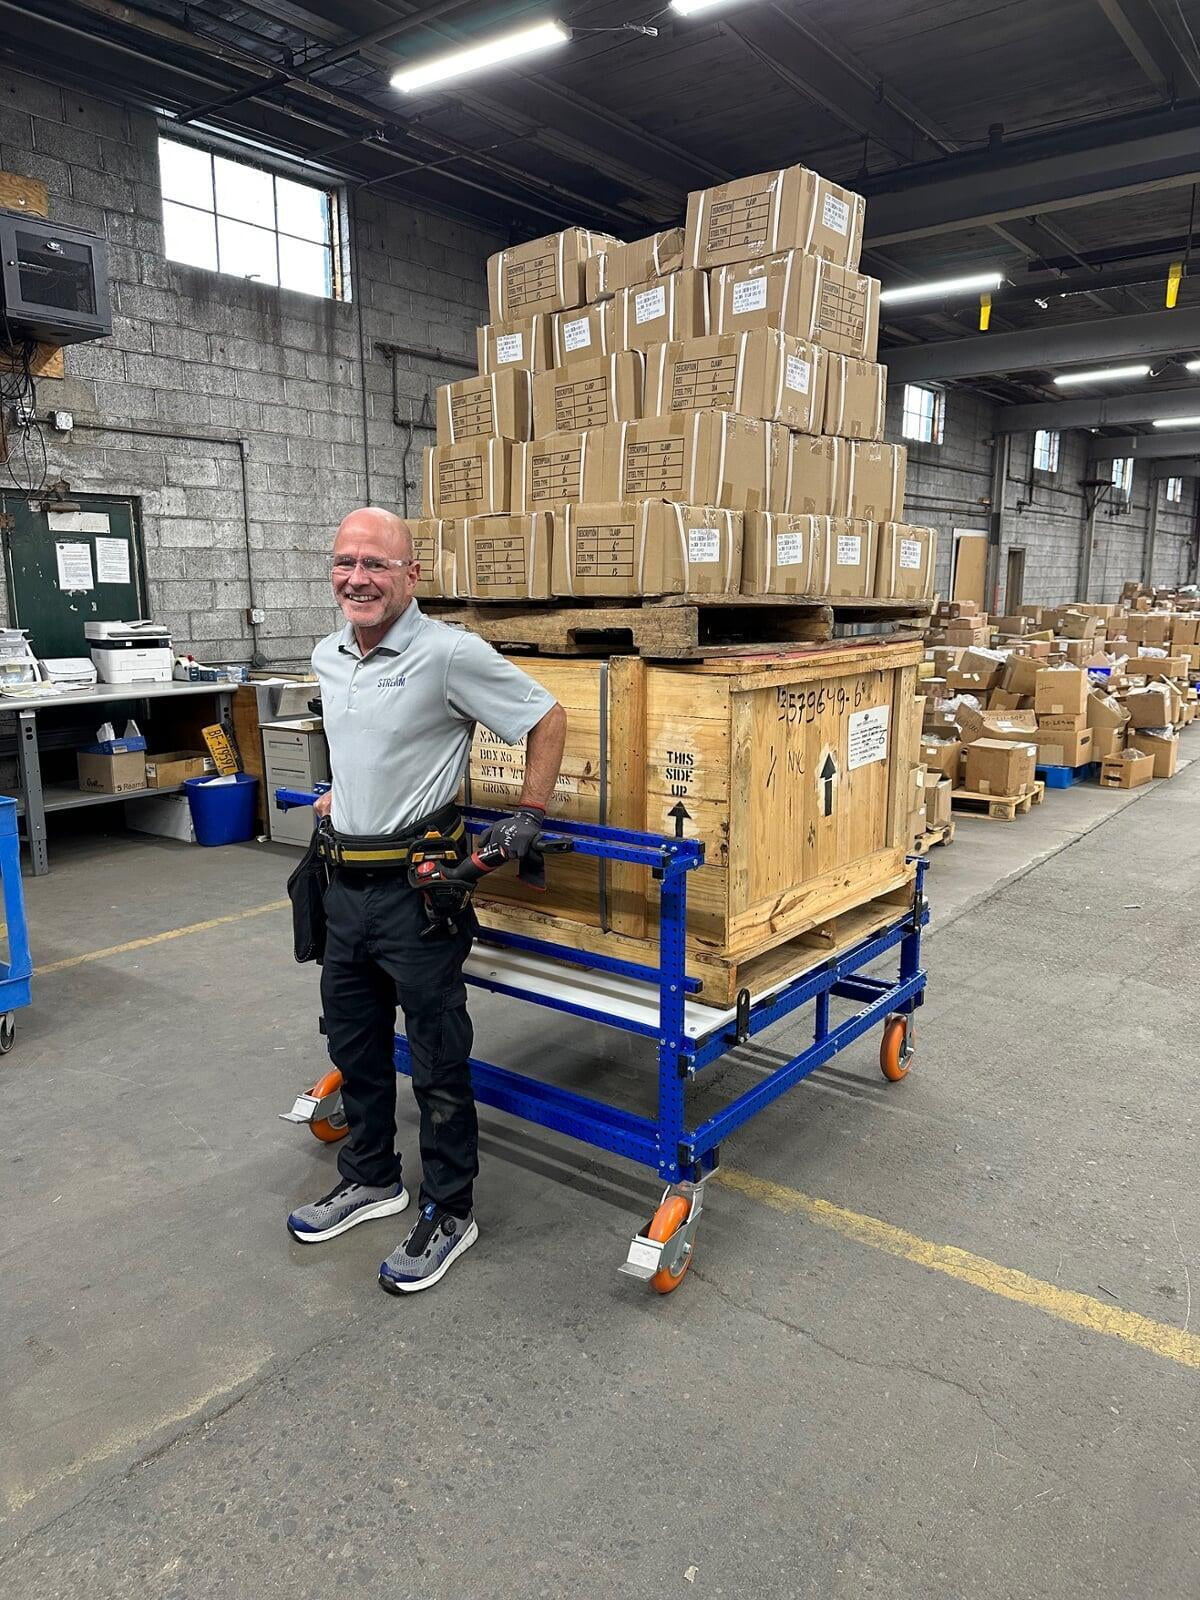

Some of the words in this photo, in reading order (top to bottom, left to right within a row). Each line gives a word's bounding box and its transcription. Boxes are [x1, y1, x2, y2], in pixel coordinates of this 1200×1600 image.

[676, 363, 696, 372] DESCRIPTION
[629, 446, 647, 454] DESCRIPTION
[578, 529, 596, 537] DESCRIPTION
[480, 749, 498, 760] BOX
[666, 751, 694, 766] THIS
[481, 765, 504, 778] NETT
[666, 768, 693, 782] SIDE
[482, 782, 510, 795] GROSS
[671, 784, 688, 797] UP
